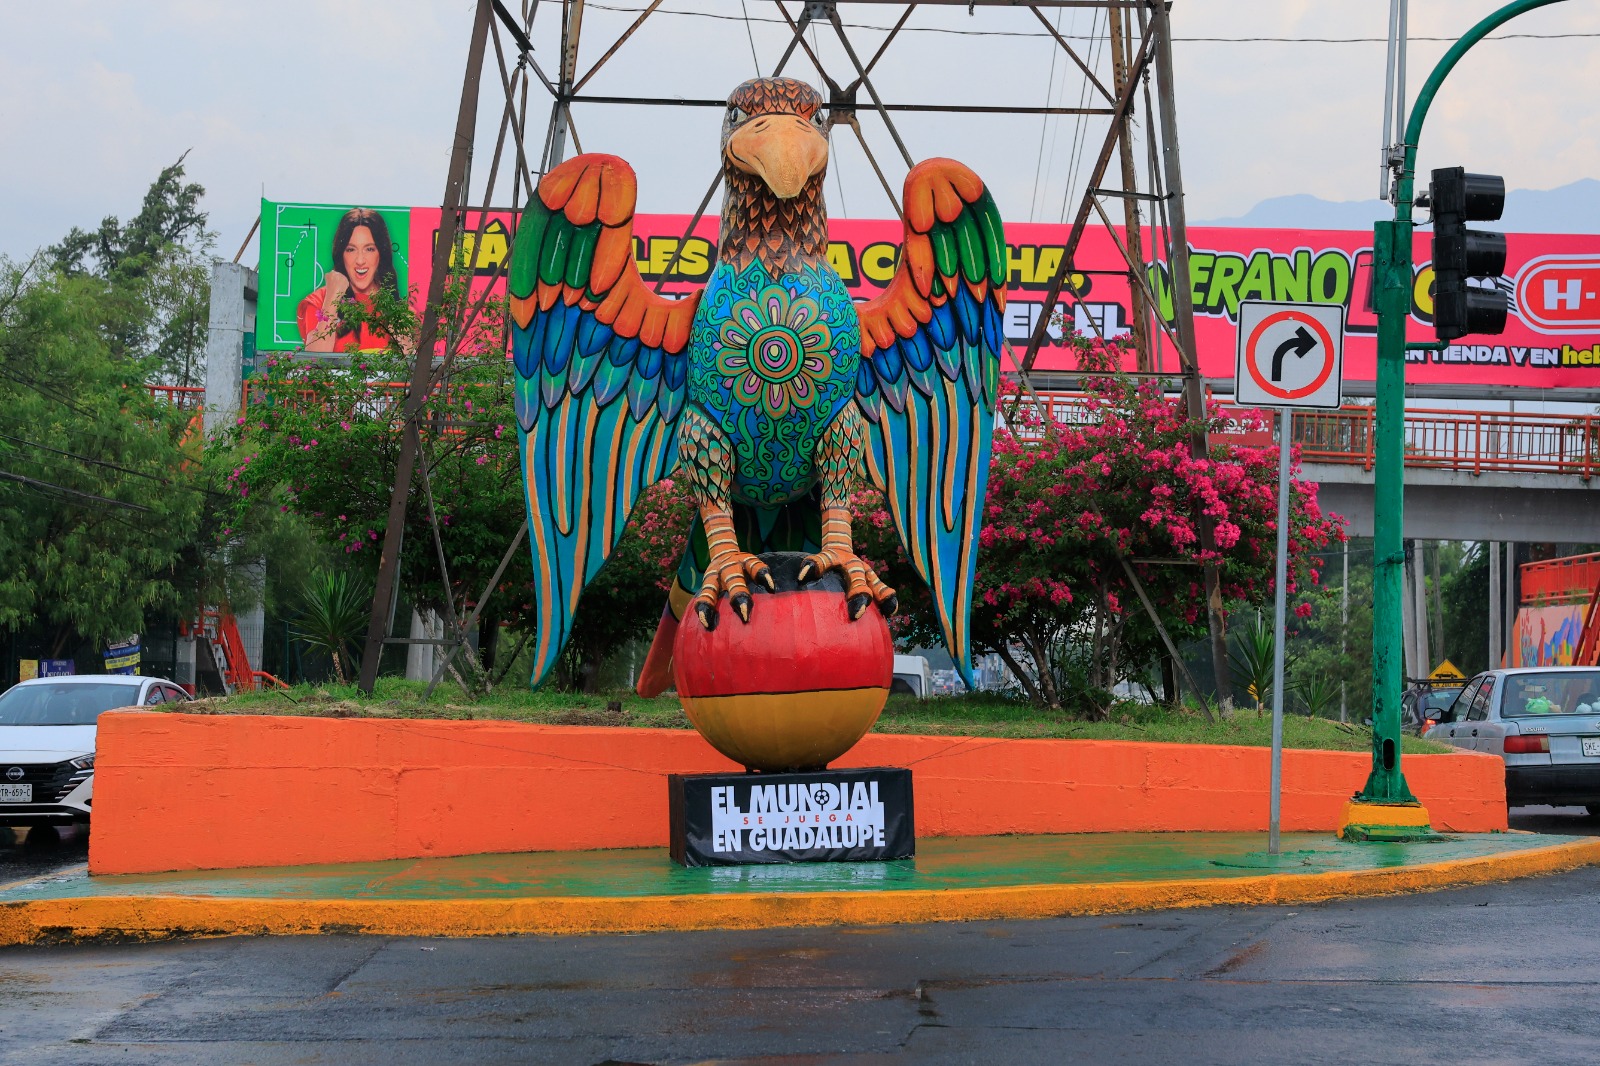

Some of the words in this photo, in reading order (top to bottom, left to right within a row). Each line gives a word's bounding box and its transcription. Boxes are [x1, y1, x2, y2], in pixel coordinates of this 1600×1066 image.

[1074, 304, 1131, 341] EL
[1511, 347, 1528, 364] Y
[1530, 349, 1559, 365] EN
[0, 788, 31, 797] TR-659-C
[711, 786, 741, 814] EL
[750, 781, 884, 813] MUNDIAL
[743, 816, 763, 825] SE
[784, 813, 853, 824] JUEGA
[713, 831, 742, 853] EN
[749, 825, 886, 851] GUADALUPE
